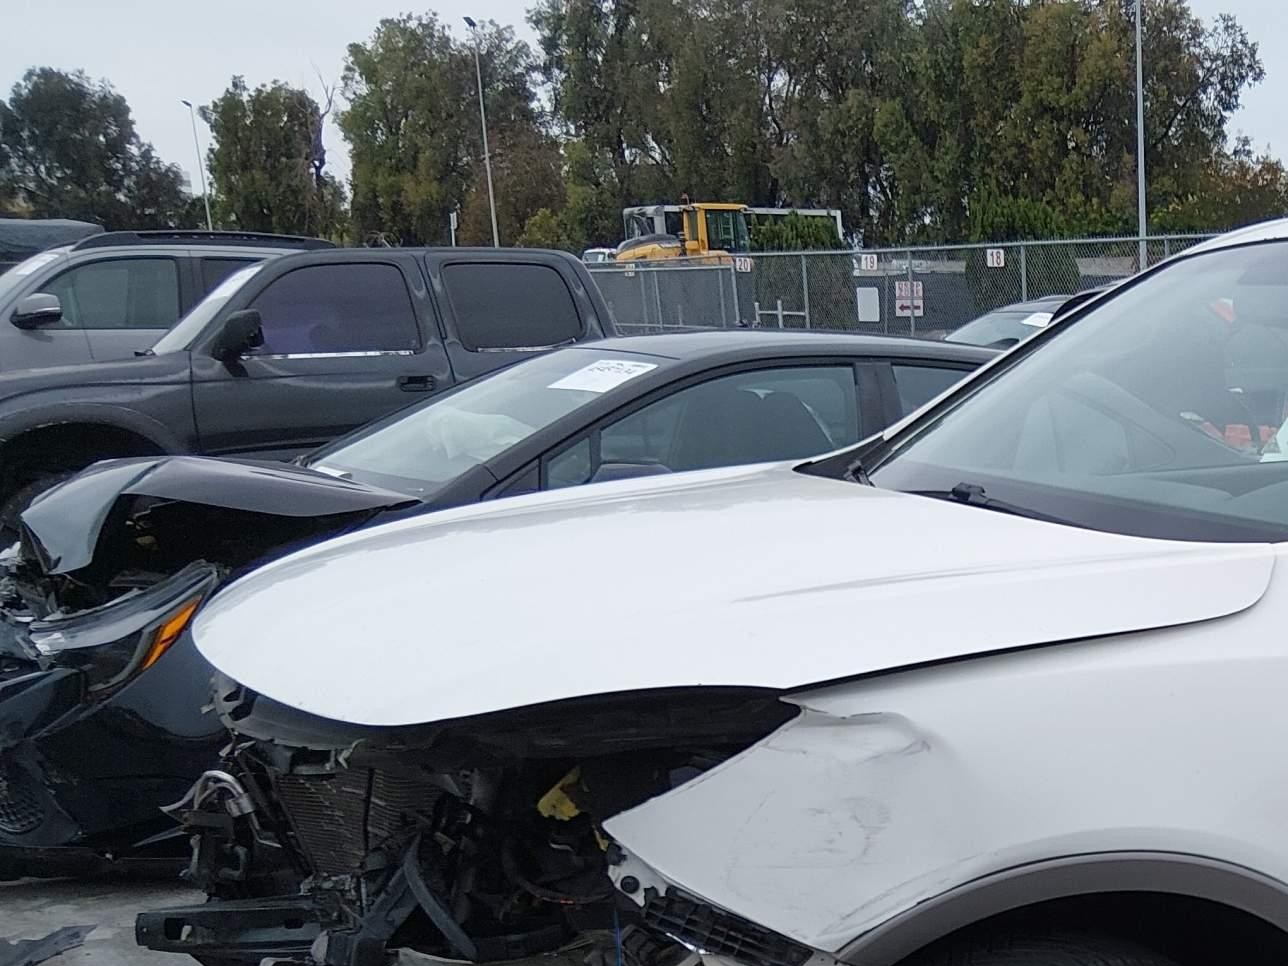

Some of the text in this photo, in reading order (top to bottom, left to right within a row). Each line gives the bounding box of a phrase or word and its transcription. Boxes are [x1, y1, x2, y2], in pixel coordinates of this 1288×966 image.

[738, 258, 749, 272] 20
[863, 254, 876, 269] 19
[990, 250, 1002, 266] 18
